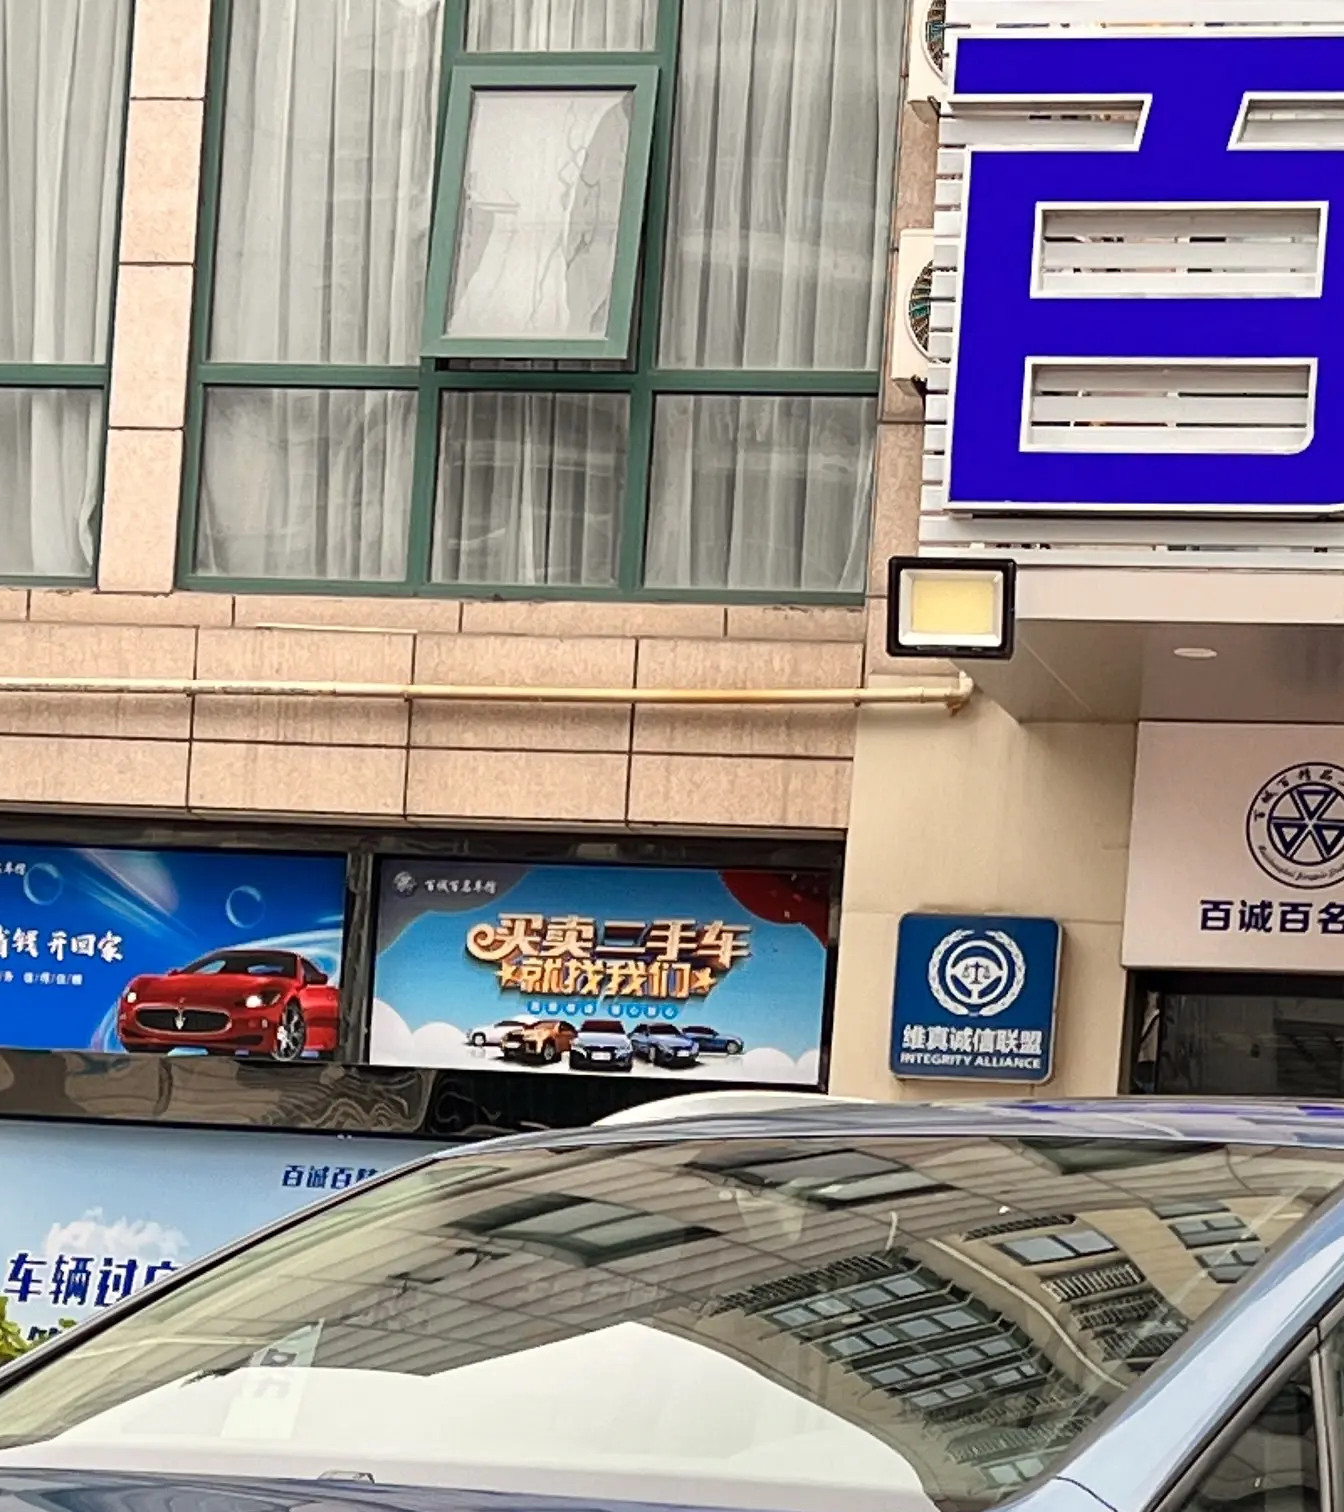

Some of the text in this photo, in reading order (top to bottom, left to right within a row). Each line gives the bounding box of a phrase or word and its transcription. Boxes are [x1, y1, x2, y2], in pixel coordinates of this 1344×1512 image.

[47, 929, 124, 963] 开回家
[465, 911, 753, 970] 买卖二手车
[520, 957, 692, 999] 就找我们
[902, 1023, 1043, 1056] 维真诚信联盟
[900, 1051, 1042, 1070] INTEGRITY ALLIANCE
